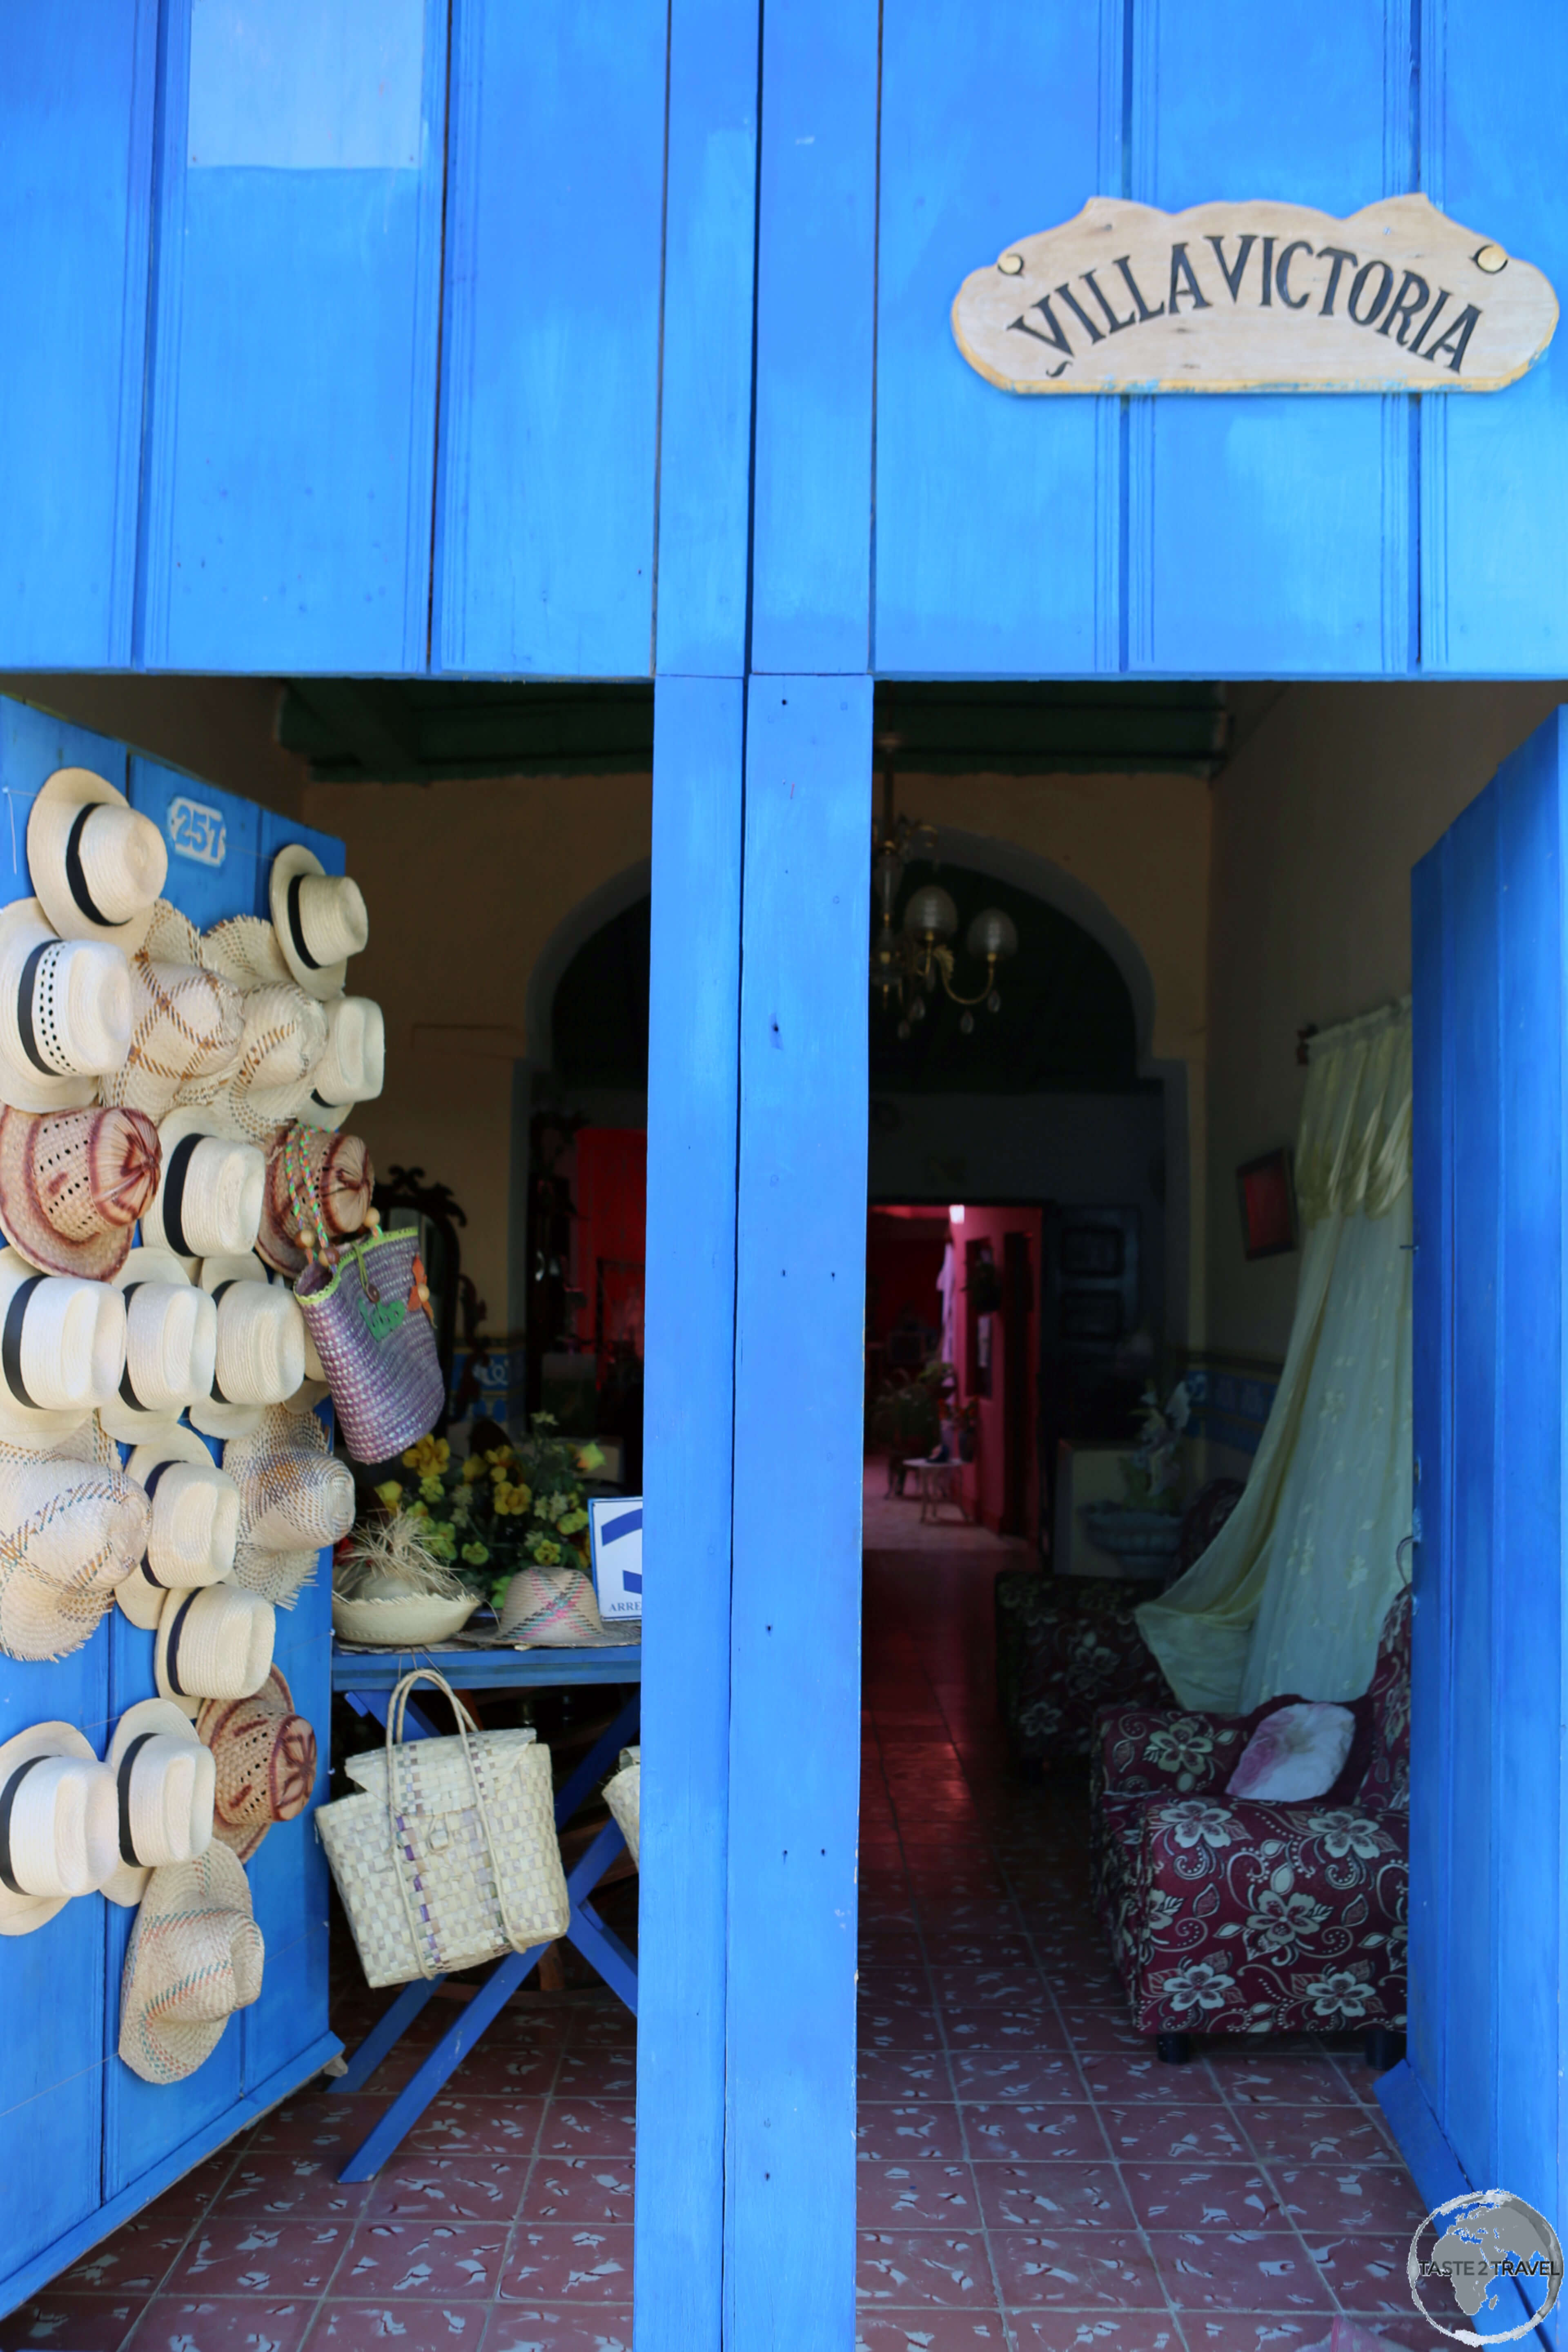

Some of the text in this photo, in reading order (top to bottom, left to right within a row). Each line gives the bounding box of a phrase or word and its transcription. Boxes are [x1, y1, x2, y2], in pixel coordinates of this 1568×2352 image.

[1007, 234, 1482, 375] VILLA VICTORIA
[175, 803, 223, 859] 257
